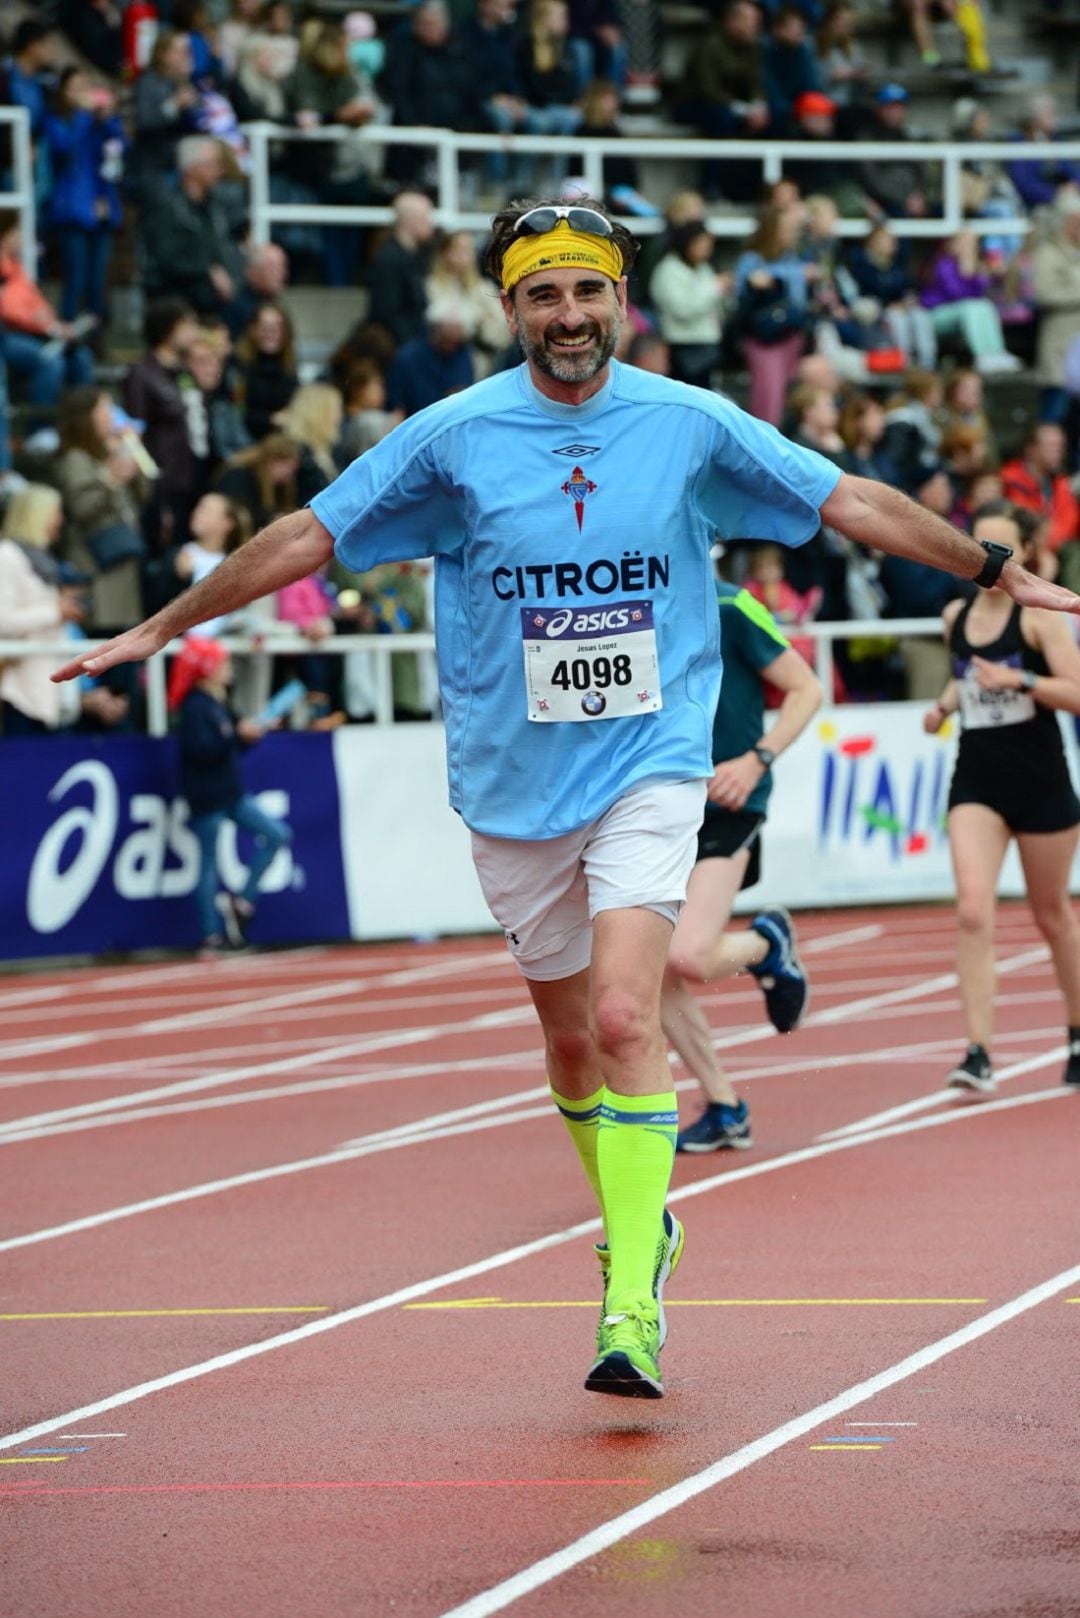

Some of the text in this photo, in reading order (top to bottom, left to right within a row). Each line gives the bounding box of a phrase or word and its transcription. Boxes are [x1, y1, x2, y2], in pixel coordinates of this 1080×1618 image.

[491, 550, 670, 601] CITROËN
[598, 642, 618, 653] Lopez
[551, 654, 632, 691] 4098
